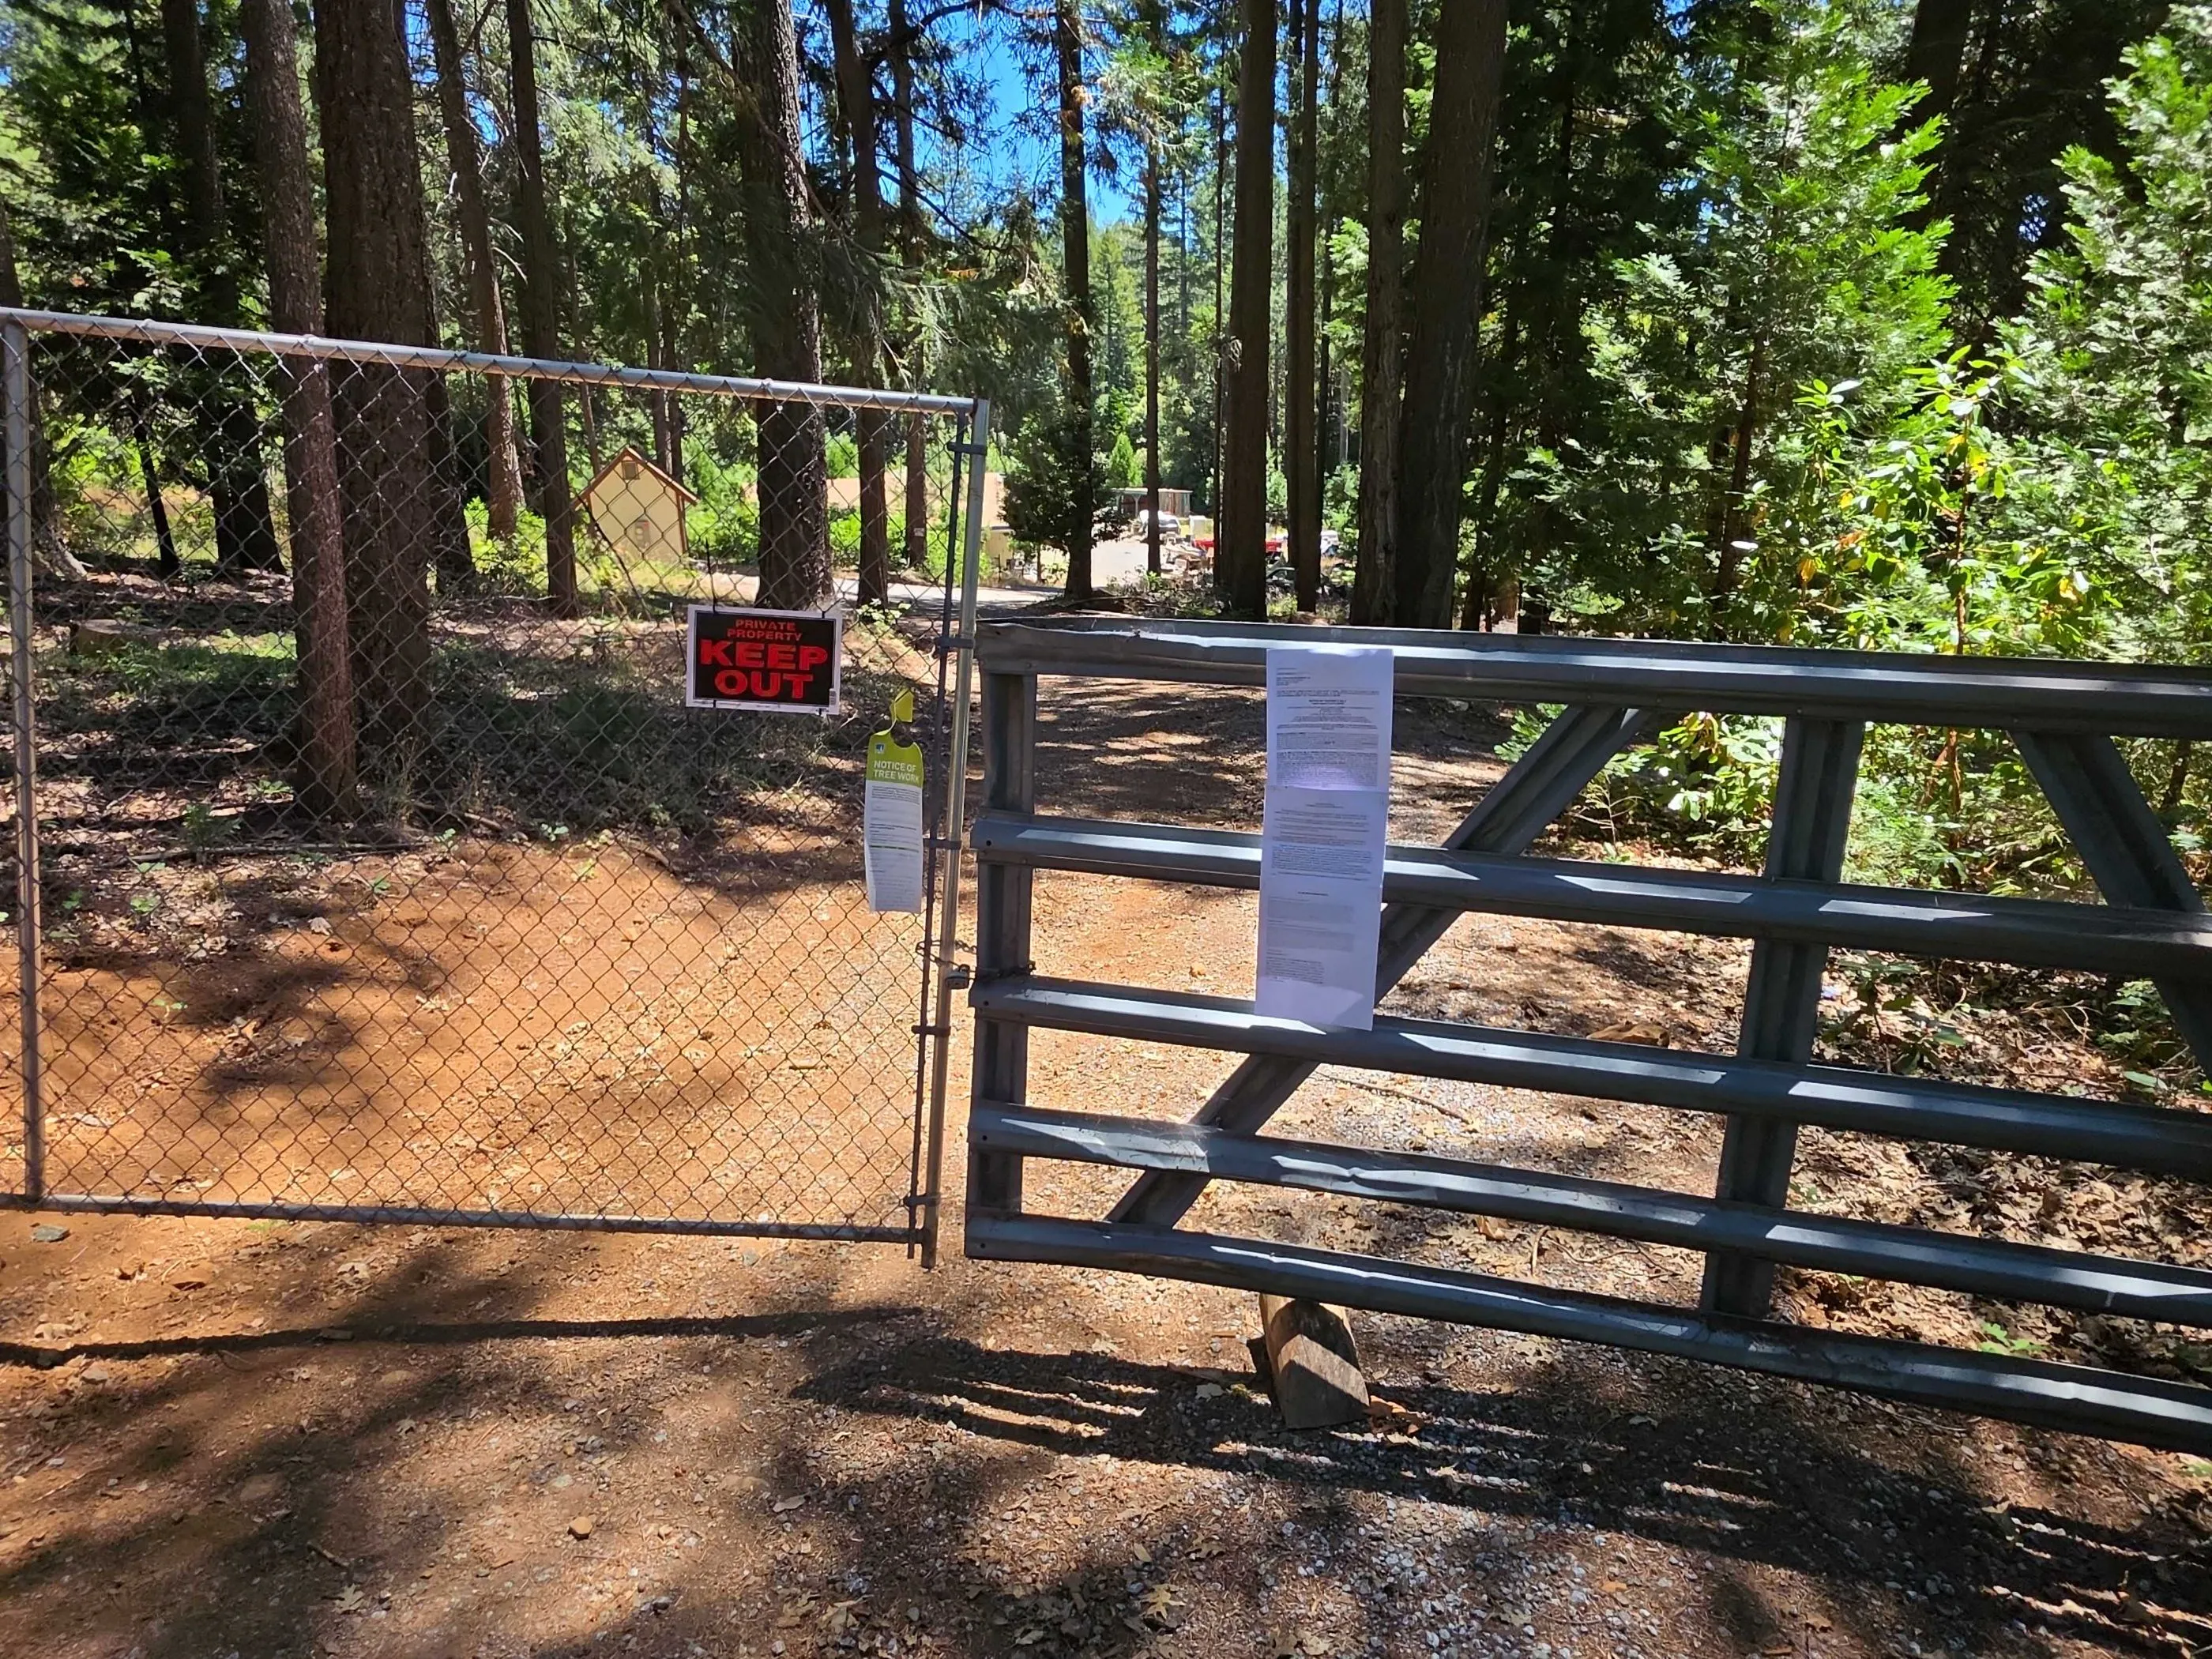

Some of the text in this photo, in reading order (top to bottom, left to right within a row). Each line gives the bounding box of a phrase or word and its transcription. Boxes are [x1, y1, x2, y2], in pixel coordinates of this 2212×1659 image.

[735, 619, 796, 630] PRIVATE
[727, 630, 803, 641] PROPERTY
[701, 639, 828, 670] KEEP
[715, 670, 813, 698] OUT
[874, 761, 916, 773] NOTICE OF
[874, 769, 920, 782] TREE WORK
